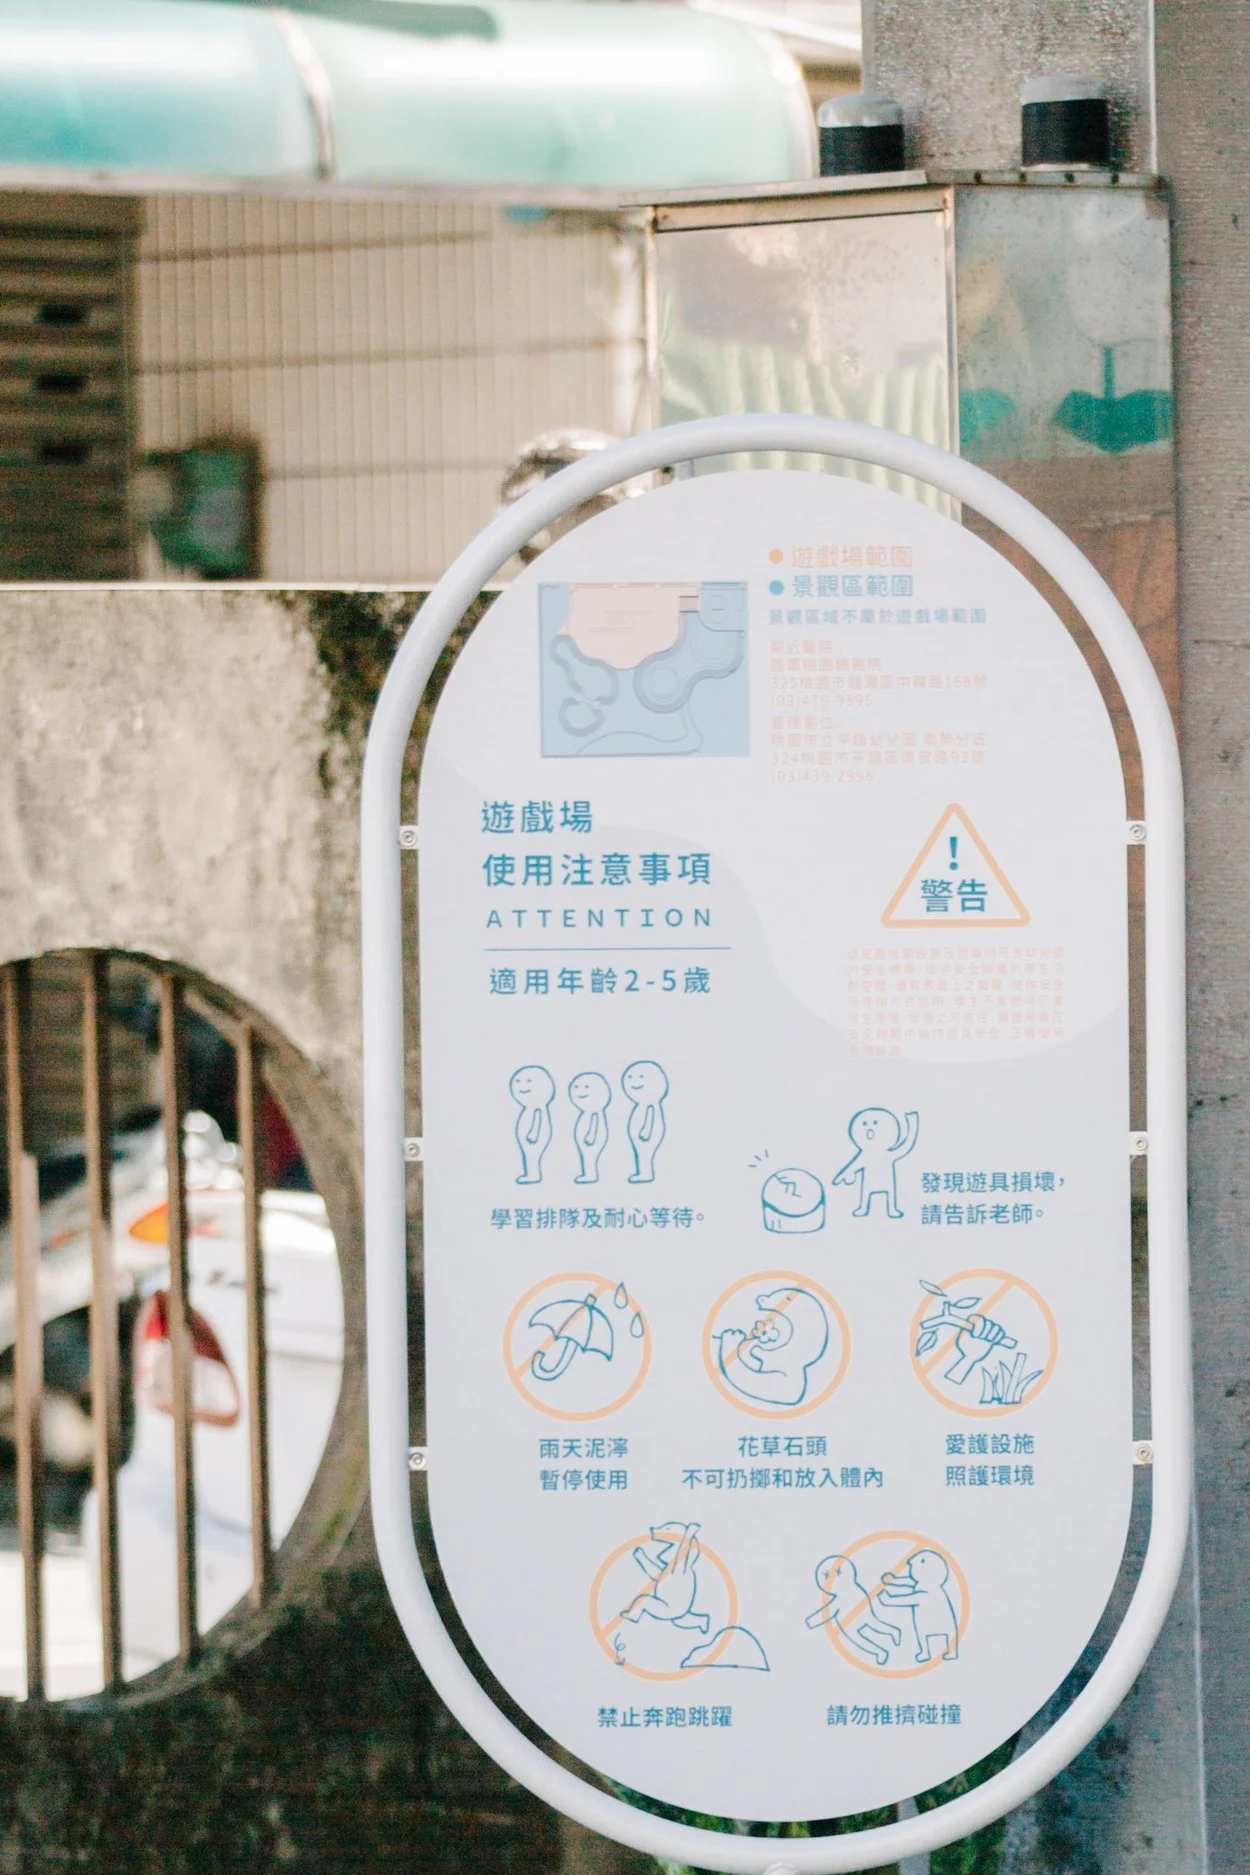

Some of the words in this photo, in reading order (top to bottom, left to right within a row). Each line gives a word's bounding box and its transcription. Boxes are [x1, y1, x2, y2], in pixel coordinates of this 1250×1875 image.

[792, 545, 913, 569] 遊戲場範圍
[792, 574, 913, 598] 景觀區範圍
[481, 800, 592, 834] 遊戲場
[482, 852, 710, 887] 使用注意事項
[921, 879, 988, 912] 警告
[486, 908, 710, 928] ATTENTION
[490, 966, 710, 995] 適用年齡2-5歲
[491, 1207, 704, 1229] 學習排隊及耐心等待。
[921, 1203, 1043, 1225] 請告訴老師。
[539, 1437, 628, 1459] 雨天泥濘
[738, 1436, 826, 1457] 花草石頭
[946, 1433, 1034, 1455] 愛護設施
[540, 1469, 627, 1490] 暫停使用
[682, 1467, 883, 1489] 不可扔擲和放入體內
[946, 1465, 1034, 1486] 照護環境
[598, 1706, 732, 1728] 禁止奔跑跳躍
[827, 1704, 961, 1725] 請勿推擠碰撞
